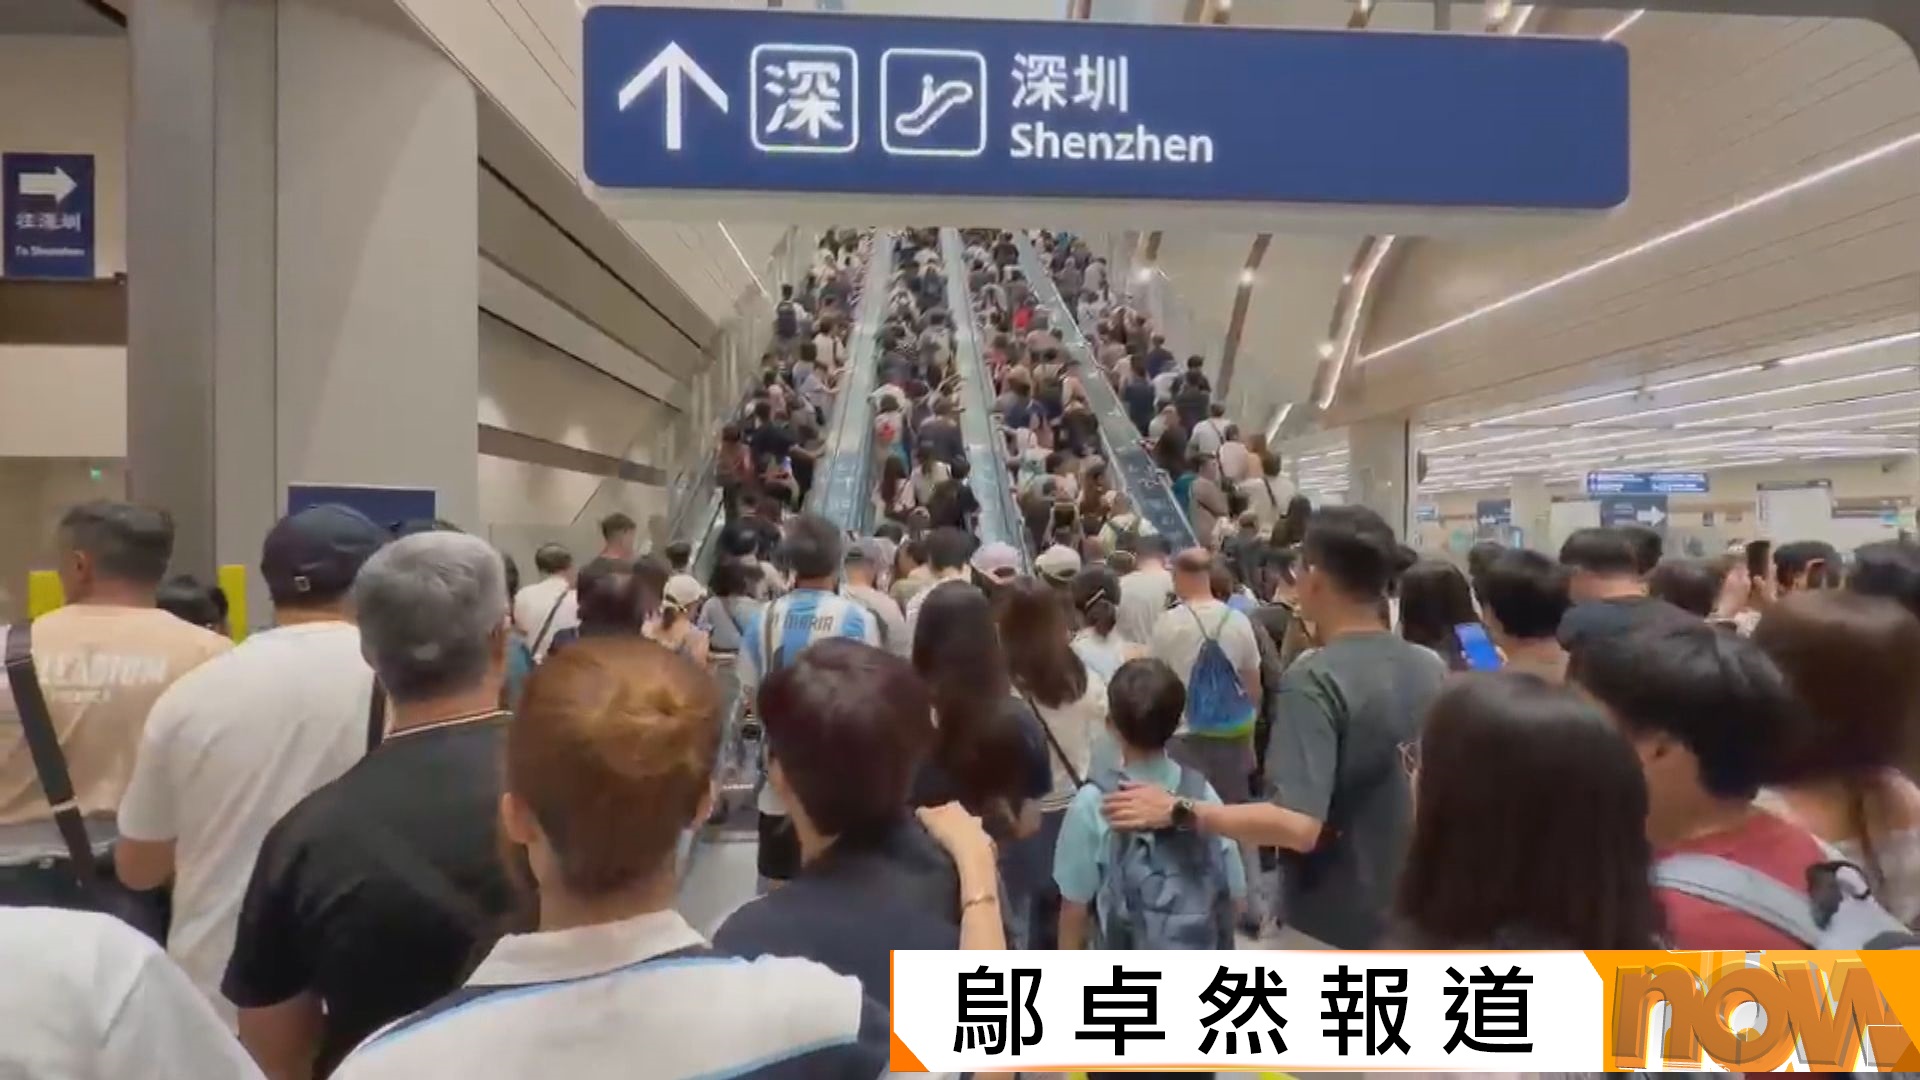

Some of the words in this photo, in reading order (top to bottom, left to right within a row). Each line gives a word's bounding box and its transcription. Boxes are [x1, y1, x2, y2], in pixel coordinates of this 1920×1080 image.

[763, 60, 844, 139] 深
[1010, 52, 1128, 113] 深圳
[1010, 121, 1214, 163] Shenzhen
